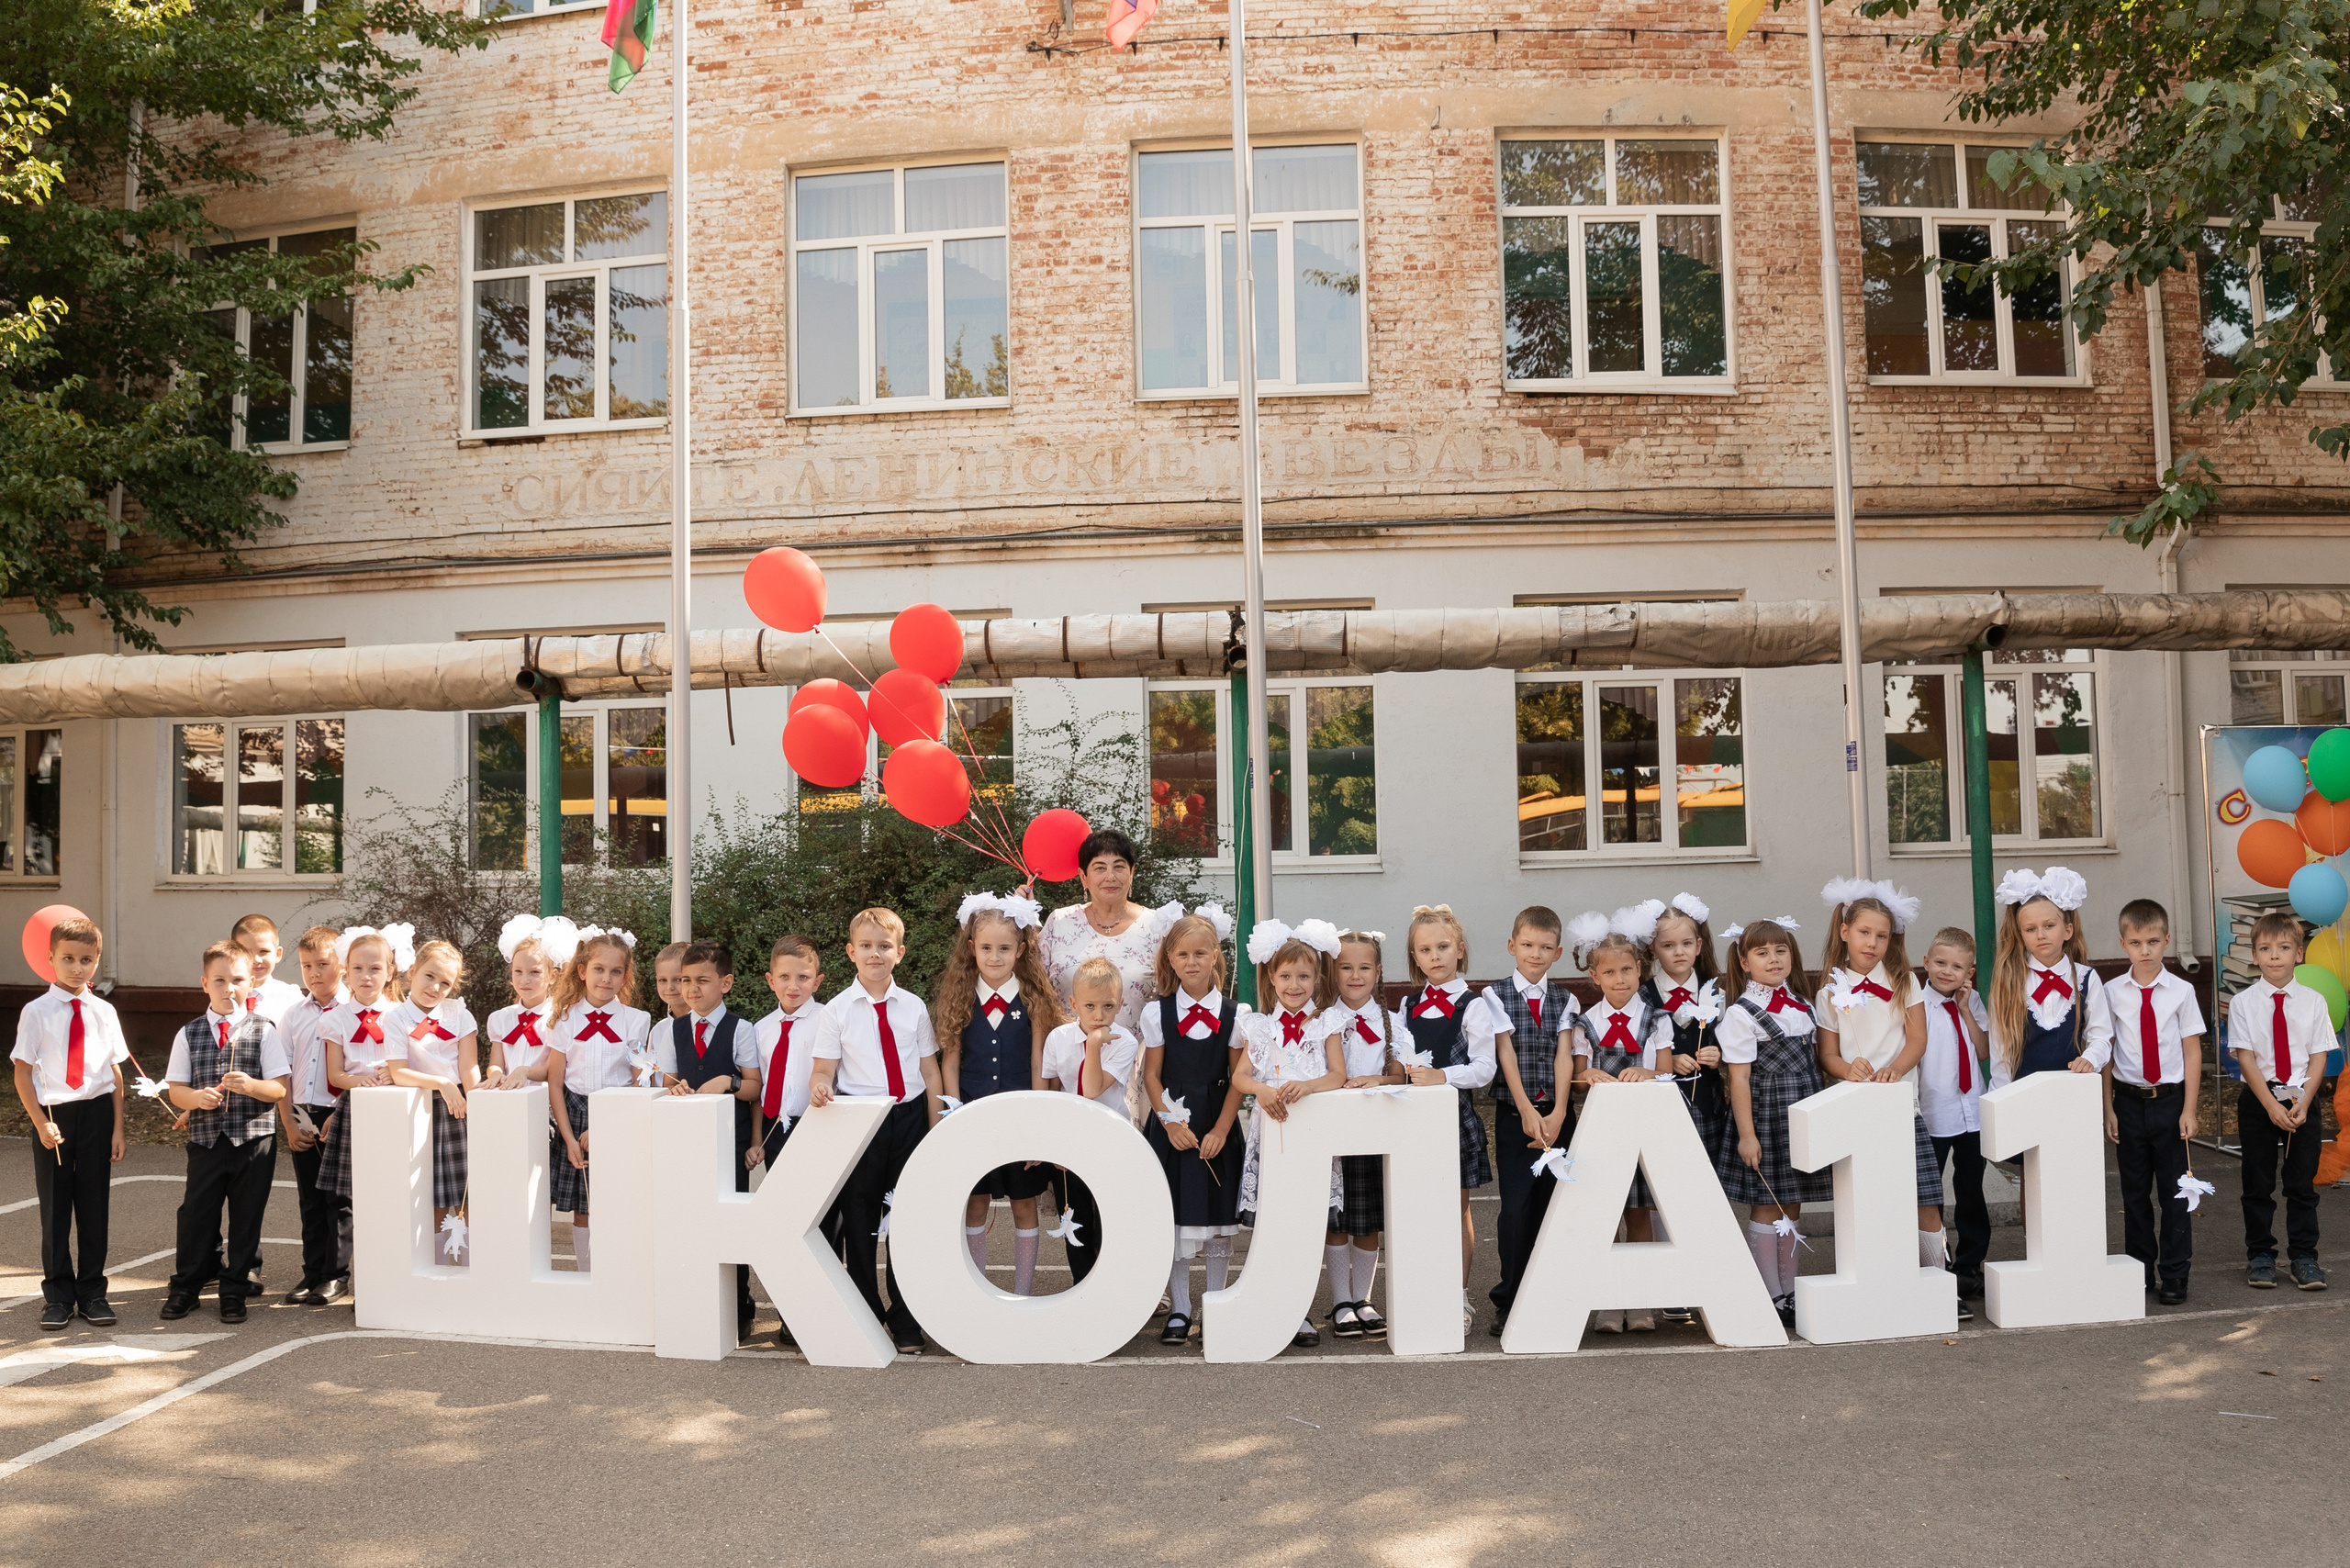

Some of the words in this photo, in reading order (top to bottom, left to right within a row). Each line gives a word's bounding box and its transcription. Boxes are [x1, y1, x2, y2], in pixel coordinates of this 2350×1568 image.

[789, 444, 1198, 501] ЛЕНИНСКИЕ
[351, 1081, 1789, 1369] ШКОЛА
[1788, 1070, 2145, 1344] 11
